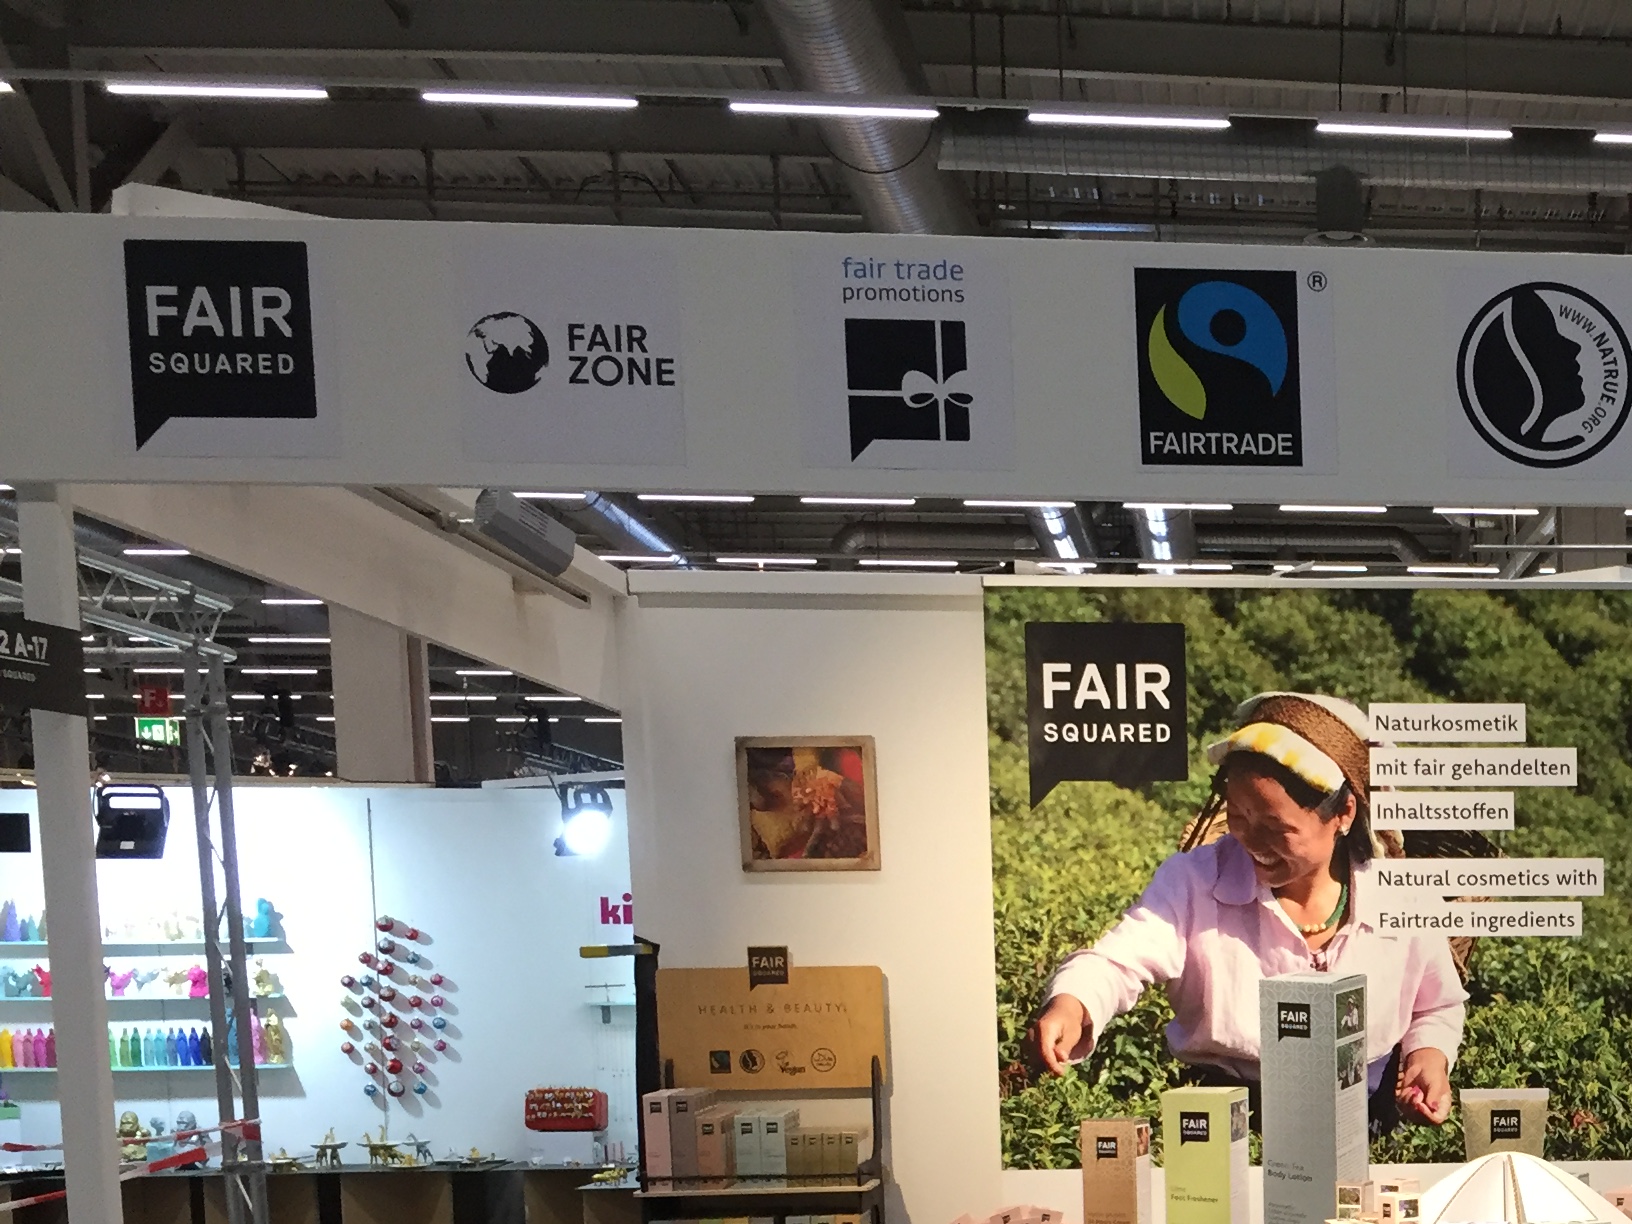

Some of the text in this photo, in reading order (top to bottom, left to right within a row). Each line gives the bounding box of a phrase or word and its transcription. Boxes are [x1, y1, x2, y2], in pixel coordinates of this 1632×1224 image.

[842, 257, 965, 282] fair trade
[842, 285, 966, 306] promotions
[144, 285, 294, 339] FAIR
[567, 323, 649, 355] FAIR
[147, 351, 296, 376] SQUARED
[568, 356, 676, 388] ZONE
[1148, 433, 1294, 458] FAIRTRADE
[14, 632, 48, 661] A-17
[1041, 662, 1171, 710] FAIR
[1042, 722, 1172, 744] SQUARED
[1374, 714, 1519, 734] Naturkosmetik
[1375, 758, 1572, 781] mit fair gehandelten
[1375, 801, 1510, 821] Inhaltsstoffen
[1377, 868, 1598, 888] Natural cosmetics with
[1378, 910, 1575, 933] Fairtrade ingredients
[752, 956, 785, 968] FAIR
[698, 1004, 757, 1016] HEALTH
[766, 1003, 775, 1014] &
[1280, 1010, 1308, 1023] FAIR
[1182, 1118, 1208, 1129] FAIR
[1493, 1116, 1518, 1127] FAIR
[1098, 1141, 1117, 1149] FAIR
